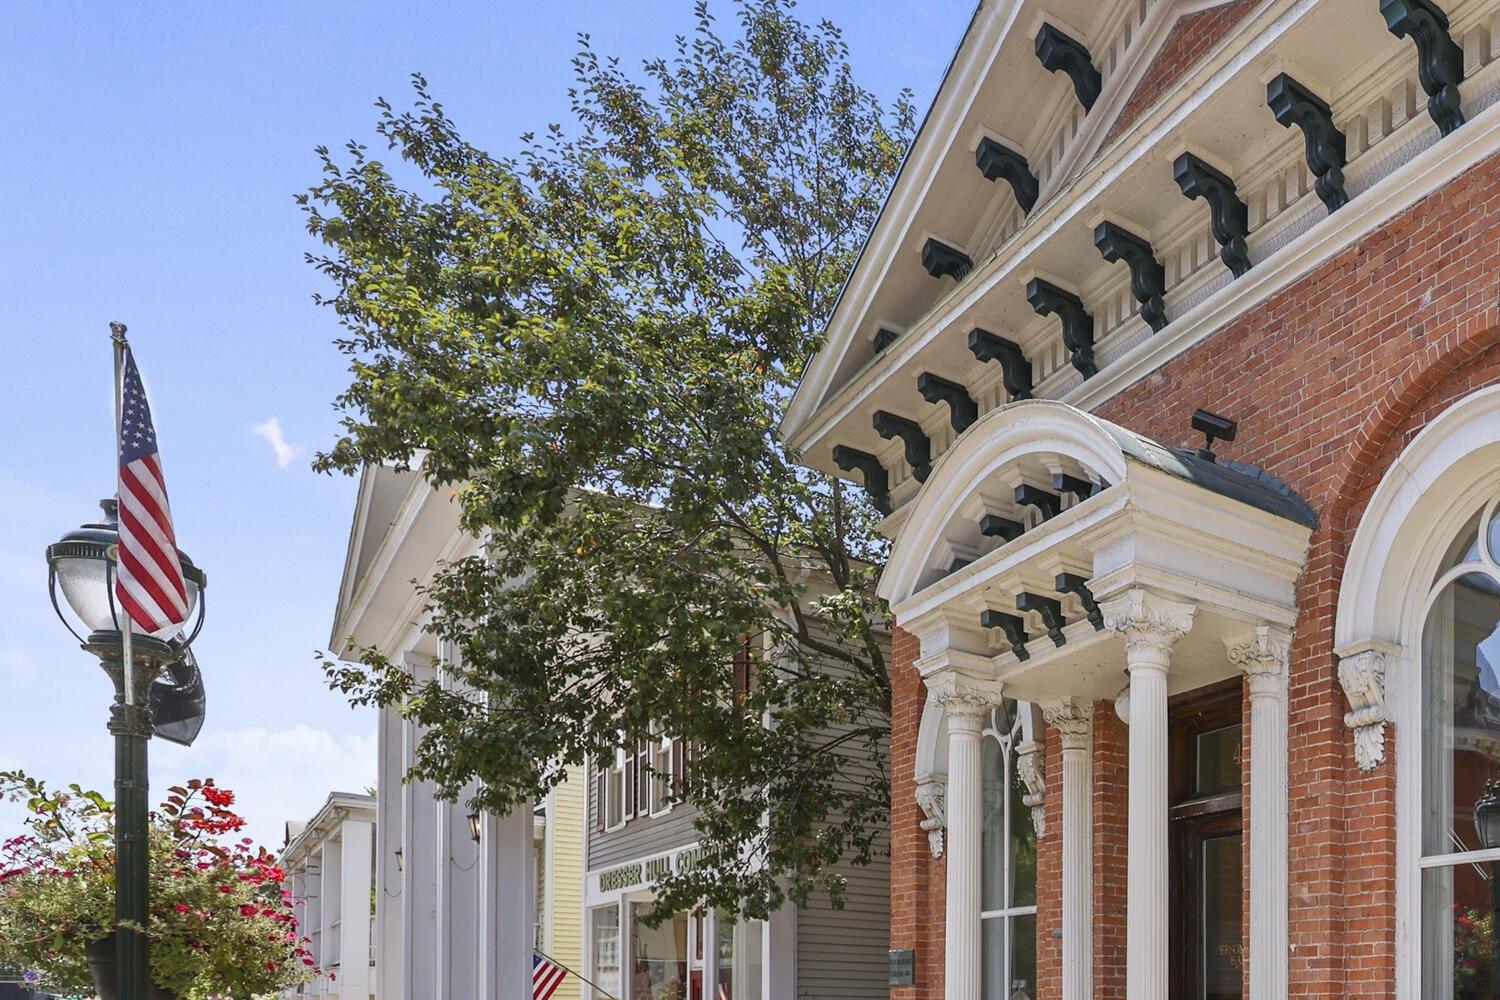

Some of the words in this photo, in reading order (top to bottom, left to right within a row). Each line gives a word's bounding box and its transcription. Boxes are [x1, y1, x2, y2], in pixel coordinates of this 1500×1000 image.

[1232, 742, 1242, 765] 4
[600, 863, 642, 893] DRESSER
[645, 856, 671, 882] HULL
